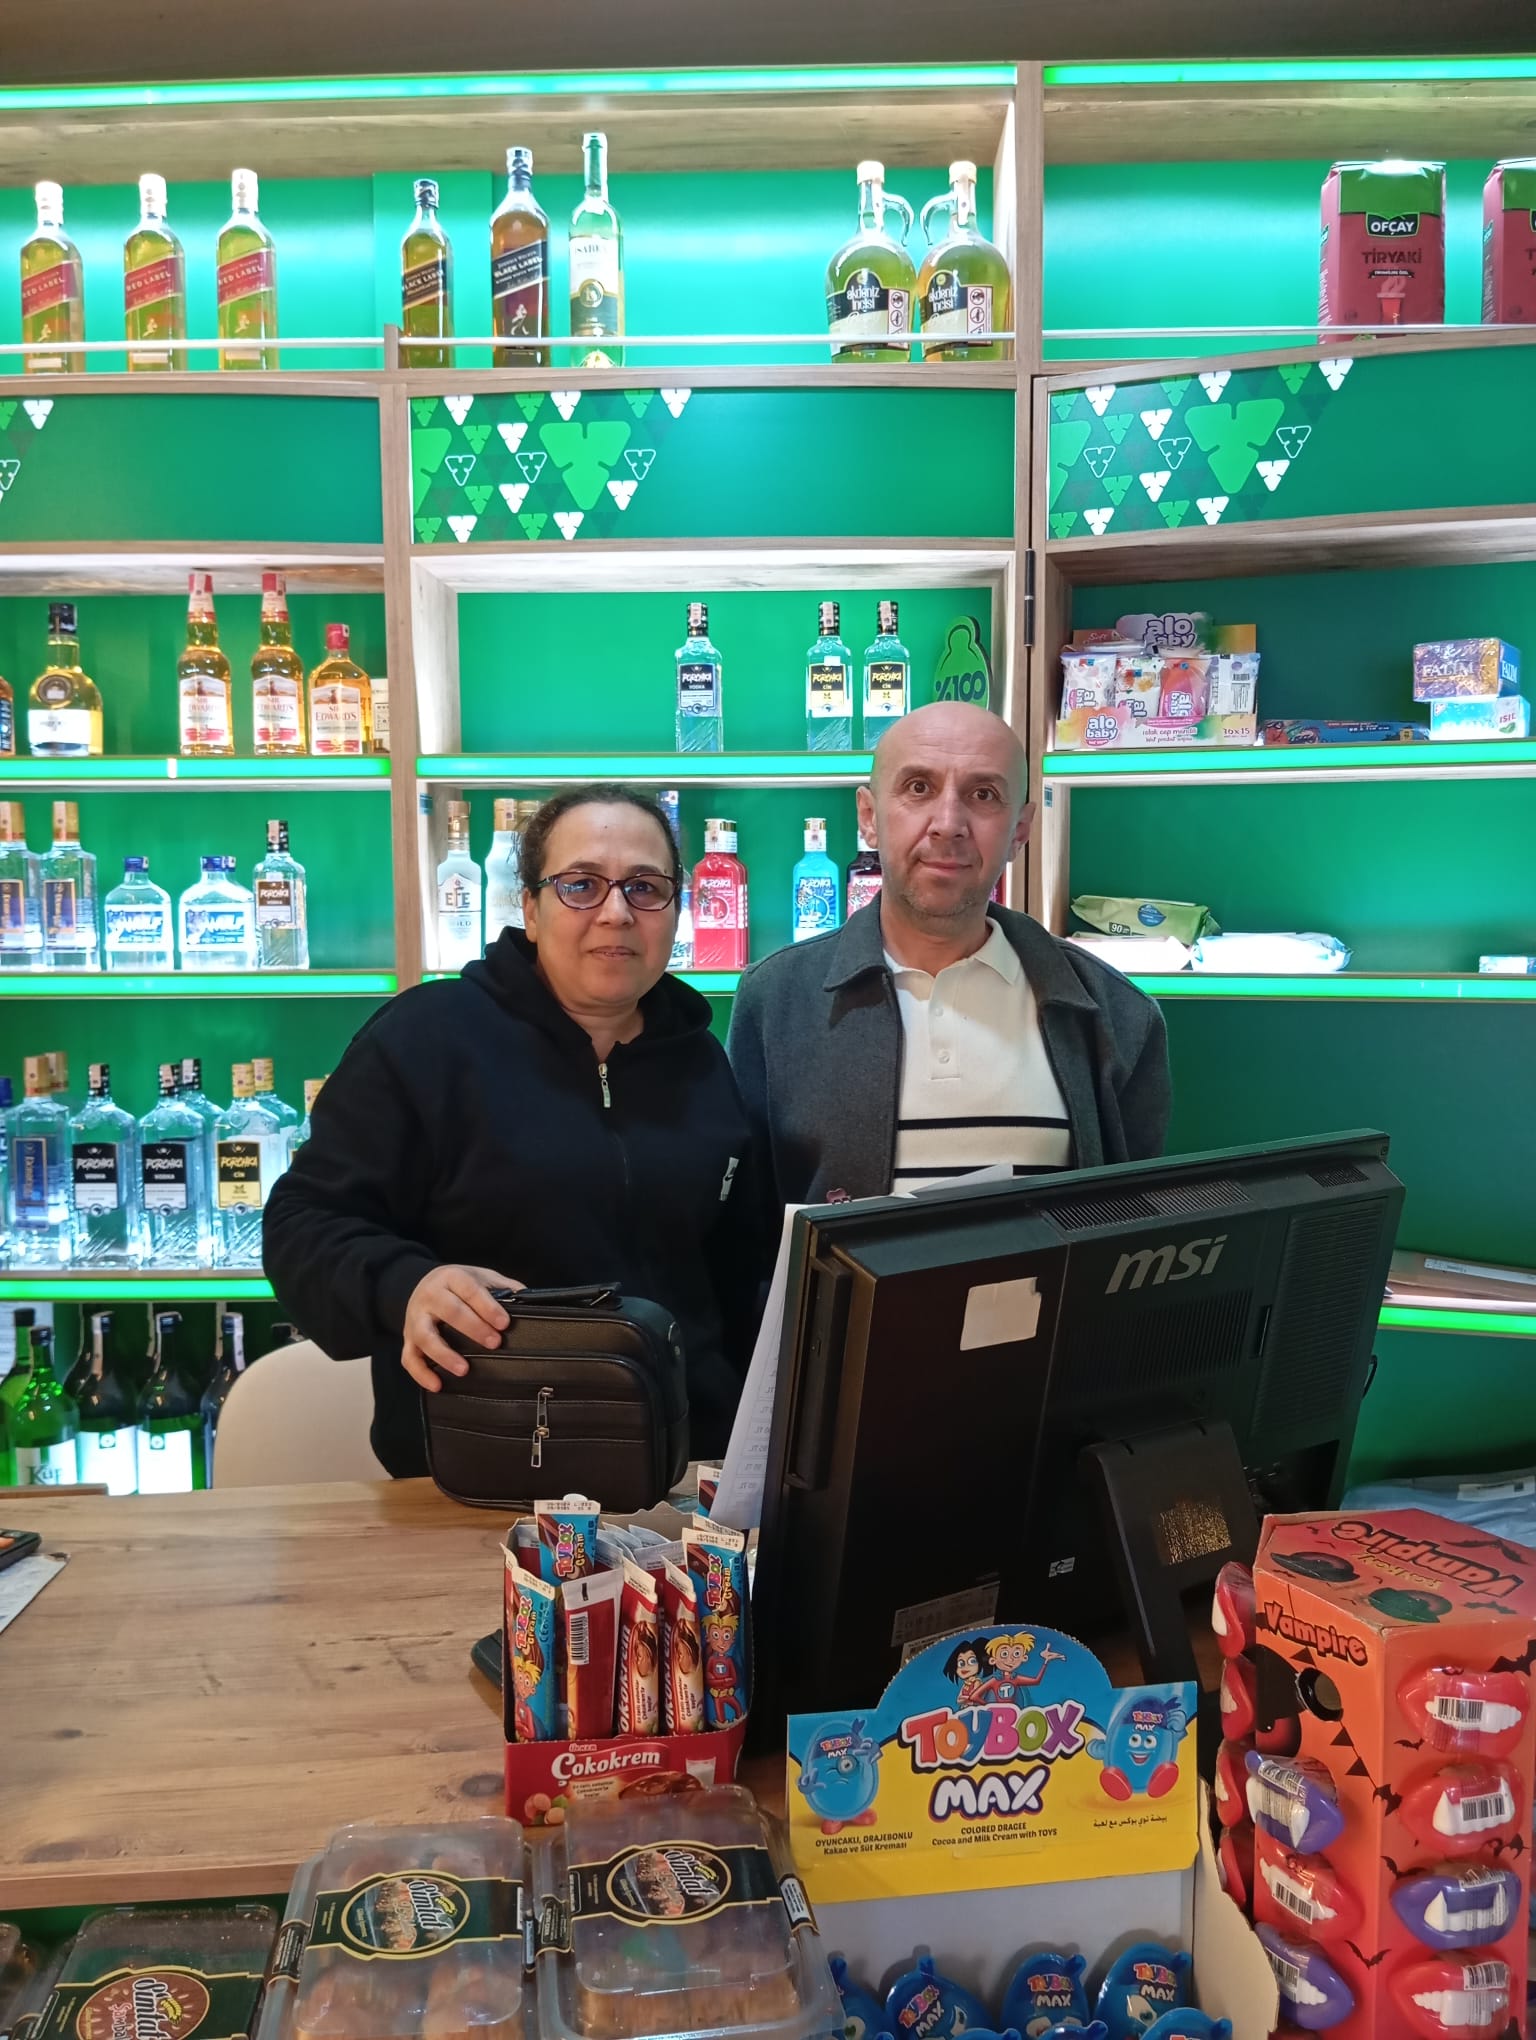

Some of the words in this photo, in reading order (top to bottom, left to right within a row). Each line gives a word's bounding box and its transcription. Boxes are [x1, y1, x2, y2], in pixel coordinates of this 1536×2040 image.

[1370, 221, 1414, 236] OFÇAY
[1361, 247, 1422, 264] TİRYAKİ
[144, 271, 171, 286] LABEL
[235, 265, 263, 279] LABEL
[1146, 614, 1193, 635] alo
[935, 671, 986, 702] %100
[1088, 715, 1117, 731] alo
[1086, 728, 1118, 740] baby
[445, 886, 471, 908] EFE
[1111, 924, 1122, 933] 90
[1105, 1234, 1228, 1295] msi
[1331, 1520, 1524, 1598] Vampire
[1264, 1601, 1368, 1667] Vampire
[1135, 1723, 1155, 1731] MAX
[827, 1748, 848, 1759] MAX
[551, 1751, 660, 1787] Çokokrem
[933, 1768, 1047, 1818] MAX
[932, 1838, 956, 1846] Cocoa
[957, 1836, 972, 1844] and
[974, 1834, 990, 1843] Milk
[992, 1833, 1018, 1841] Cream
[1019, 1830, 1037, 1839] with
[1038, 1828, 1057, 1837] TOYS
[961, 1824, 996, 1835] COLORED
[997, 1822, 1027, 1832] DRAGEE
[824, 1847, 848, 1855] Kakao
[860, 1844, 873, 1852] Süt
[1036, 1994, 1071, 2007] MAX
[1141, 1984, 1175, 2001] MAX
[916, 2000, 945, 2038] MAX
